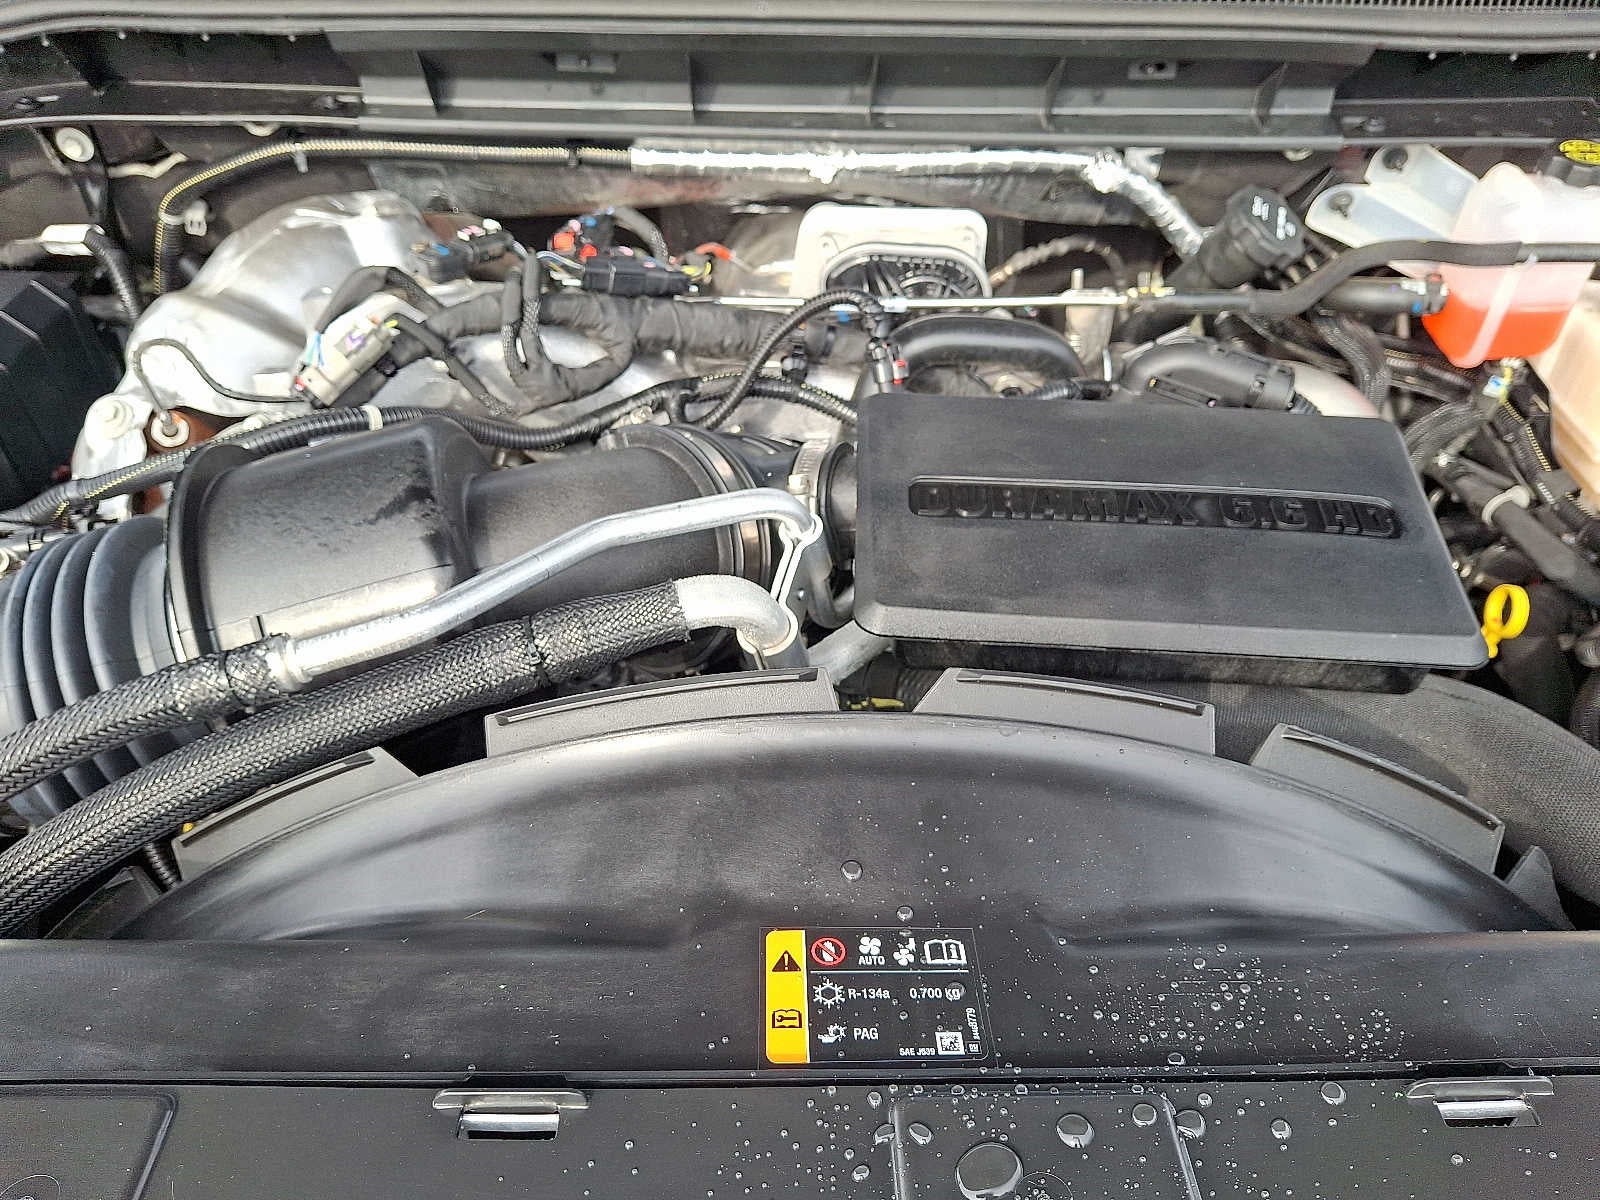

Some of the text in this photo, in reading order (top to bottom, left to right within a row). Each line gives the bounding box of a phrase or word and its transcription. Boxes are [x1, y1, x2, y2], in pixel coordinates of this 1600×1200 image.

[914, 483, 1202, 526] DURAMAX
[858, 955, 886, 966] AUTO
[848, 987, 961, 1001] R-134a 0.700 kg
[853, 1027, 879, 1041] PAG
[899, 1047, 916, 1056] SAE
